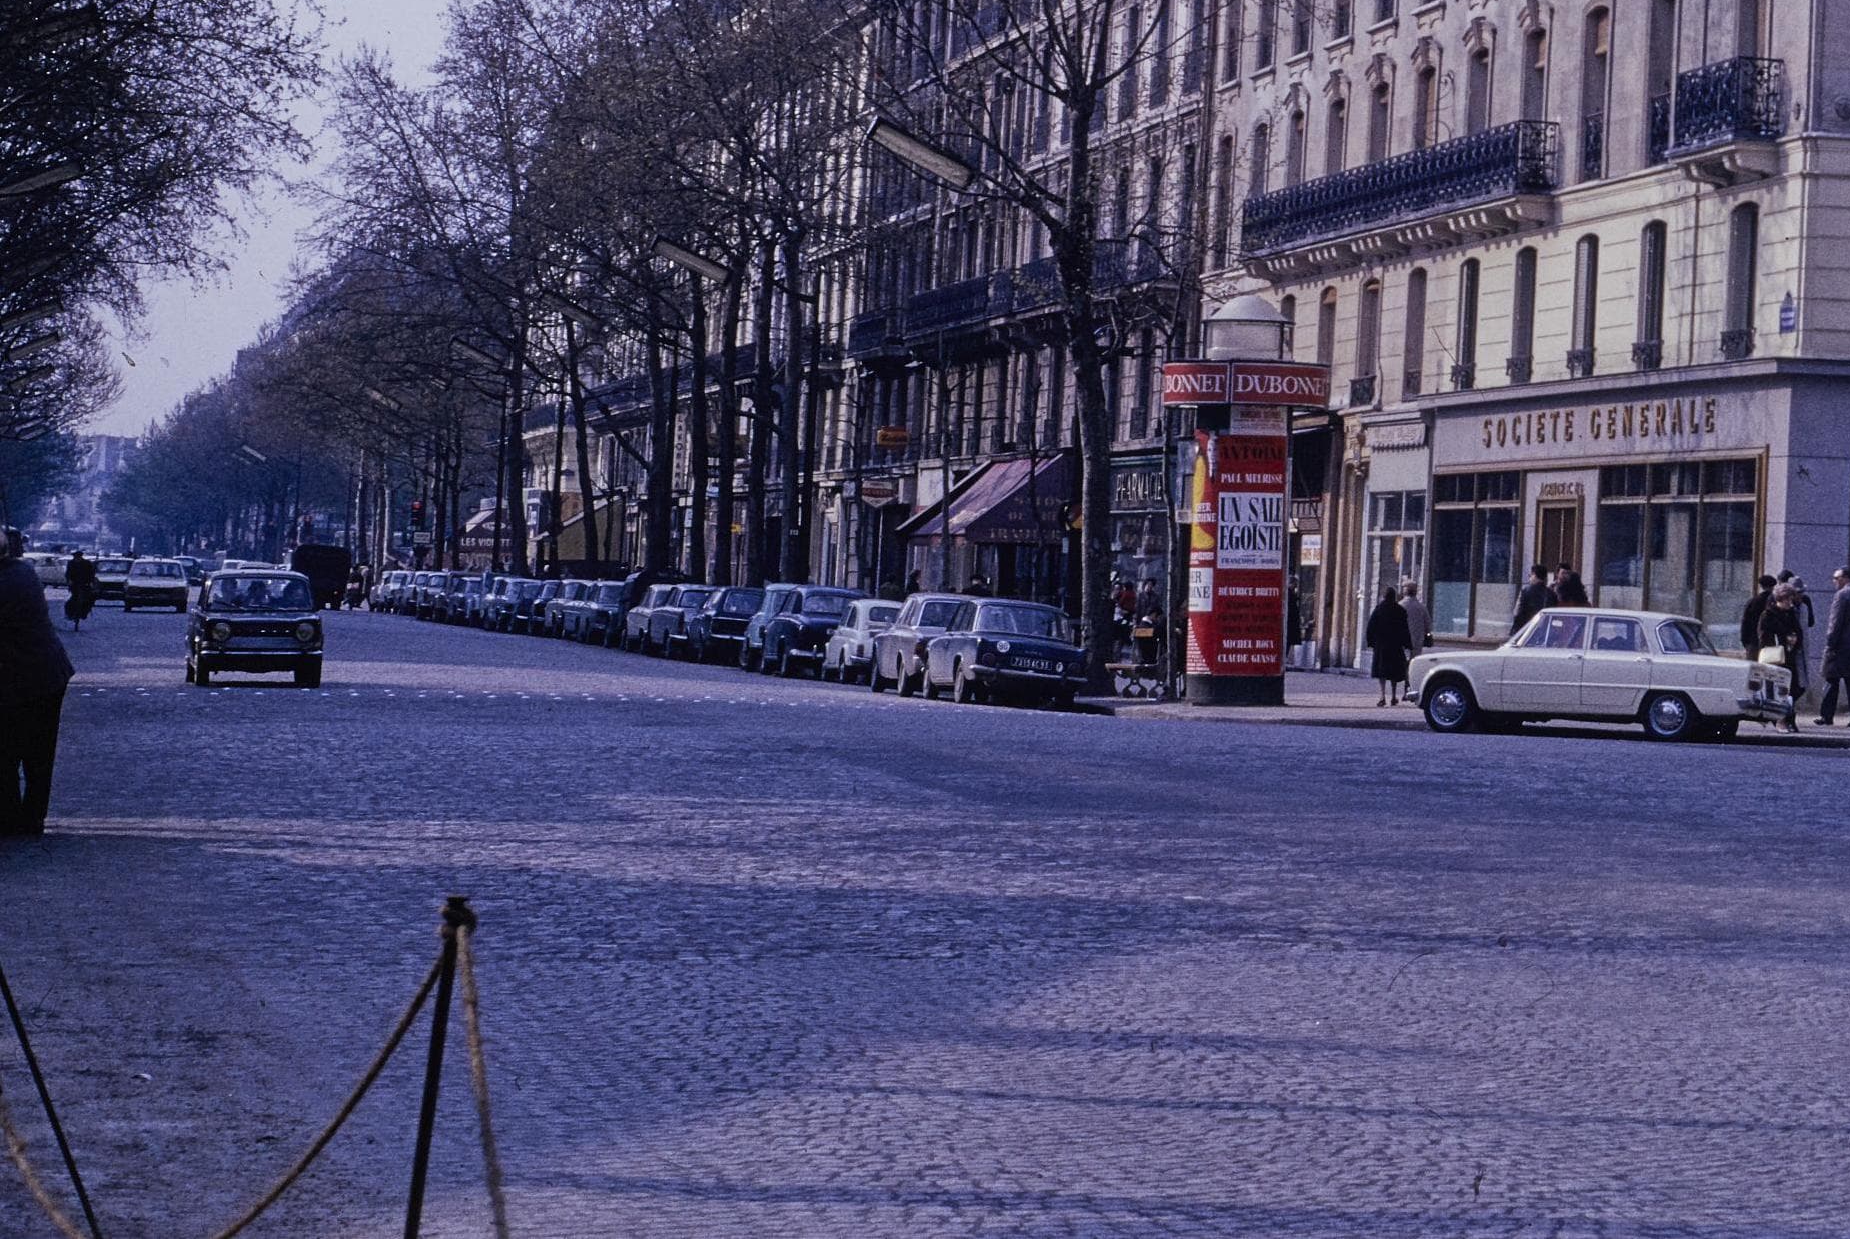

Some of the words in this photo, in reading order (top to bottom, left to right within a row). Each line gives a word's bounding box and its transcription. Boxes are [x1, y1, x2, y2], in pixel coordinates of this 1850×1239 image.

[1482, 410, 1575, 448] SOCIETE
[1590, 397, 1716, 440] GENERALE
[1220, 497, 1242, 522] UN
